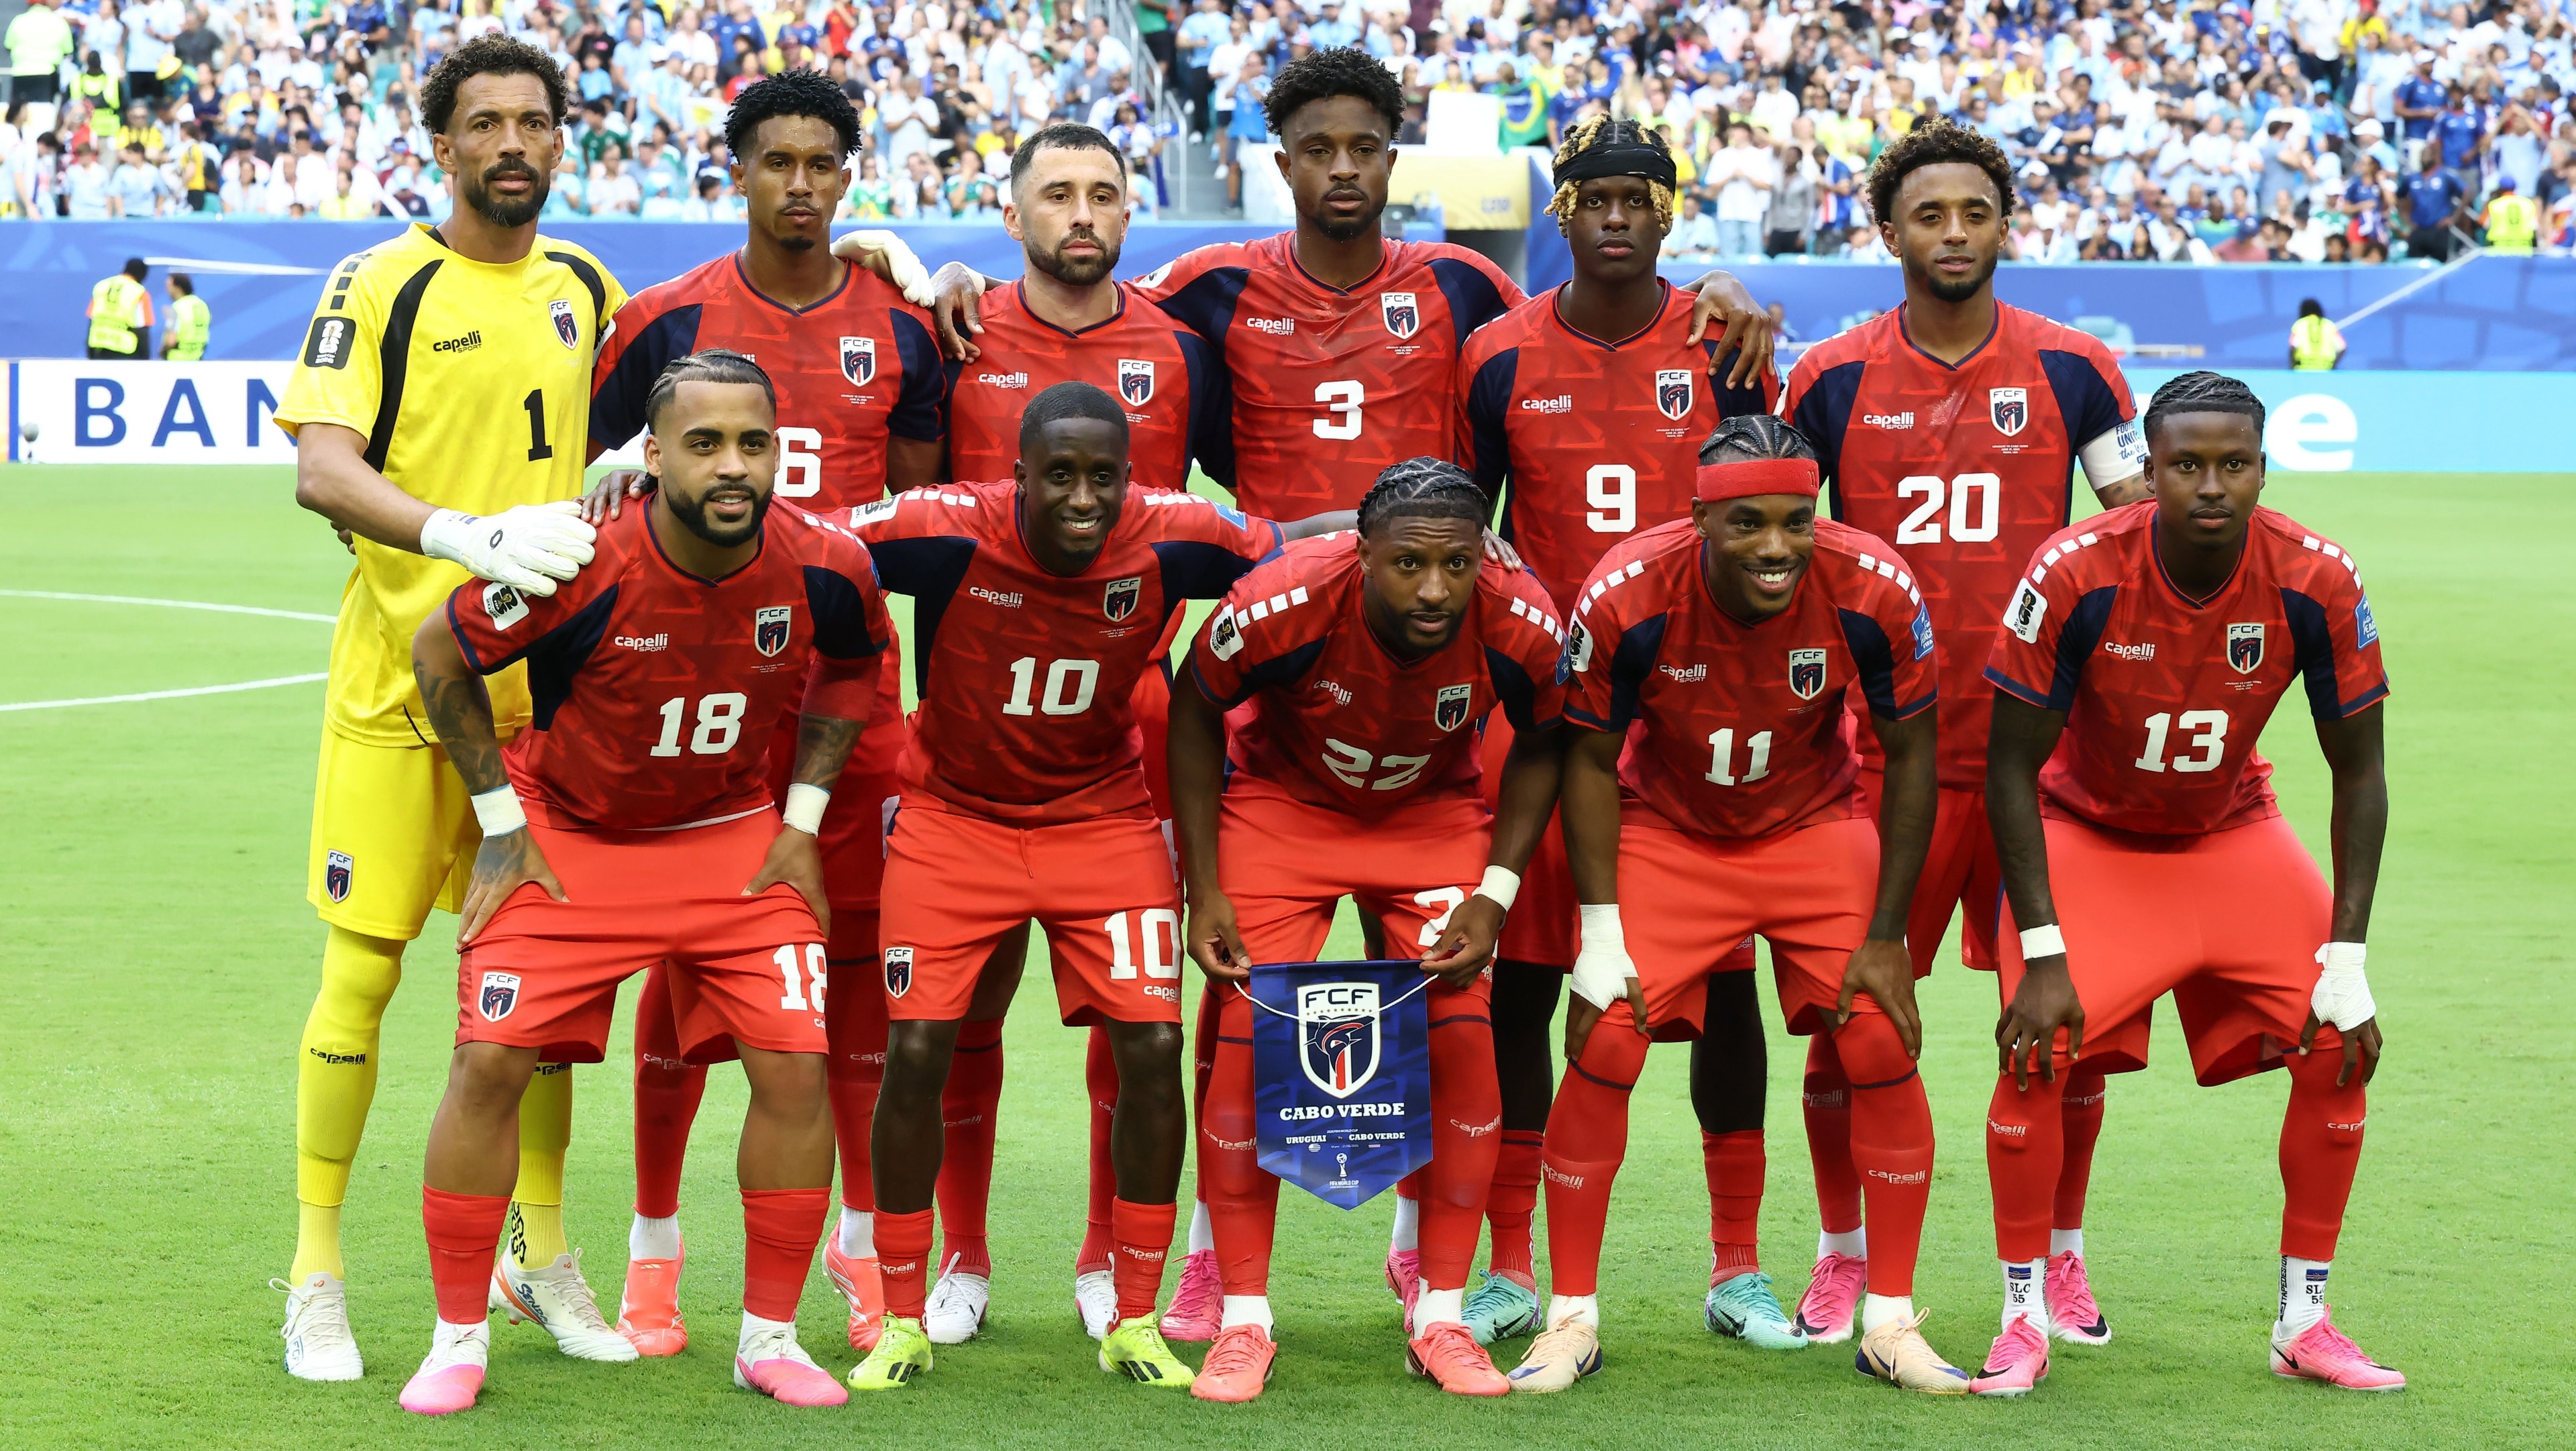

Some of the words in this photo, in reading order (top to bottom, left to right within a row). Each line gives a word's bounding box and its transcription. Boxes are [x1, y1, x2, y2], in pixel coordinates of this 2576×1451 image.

[551, 301, 568, 312] FCF
[1385, 294, 1412, 303] FCF
[1246, 317, 1295, 332] capelli
[433, 331, 481, 354] capelli
[458, 343, 482, 354] SPORT
[843, 339, 871, 347] FCF
[978, 372, 1028, 388] capelli
[1659, 372, 1688, 380] FCF
[1994, 390, 2024, 398] FCF
[1313, 380, 1364, 441] 3
[1522, 394, 1572, 413] capelli
[524, 389, 553, 462] 1
[1864, 412, 1915, 429] capelli
[773, 427, 822, 497] 6
[1586, 464, 1636, 533] 9
[1896, 472, 2000, 545] 20
[1109, 580, 1138, 590] FCF
[969, 586, 1023, 605] capelli
[758, 608, 788, 619] FCF
[2231, 625, 2261, 635] FCF
[614, 633, 668, 651] capelli
[1792, 651, 1822, 661] FCF
[2105, 641, 2155, 660] capelli
[1659, 664, 1707, 681] capelli
[1003, 657, 1099, 715] 10
[1440, 687, 1467, 698] FCF
[649, 692, 747, 757] 18
[2135, 709, 2229, 773] 13
[1322, 738, 1432, 790] 22
[1705, 727, 1772, 786] 11
[329, 852, 350, 863] FCF
[1104, 908, 1181, 979] 10
[887, 949, 911, 957] FCF
[486, 974, 519, 985] FCF
[772, 943, 827, 1013] 18
[1144, 986, 1181, 1000] capelli
[1305, 988, 1373, 1008] FCF
[311, 1048, 366, 1065] capelli
[1279, 1106, 1335, 1121] CABO
[1338, 1102, 1405, 1118] VERDE
[1450, 1114, 1500, 1137] capelli
[1286, 1134, 1327, 1144] URUGUAI
[1551, 1177, 1581, 1189] SPORT
[1868, 1169, 1925, 1184] capelli
[1122, 1246, 1163, 1262] capelli
[2010, 1282, 2031, 1293] SLC
[2013, 1293, 2025, 1303] 55
[2312, 1295, 2323, 1304] 55
